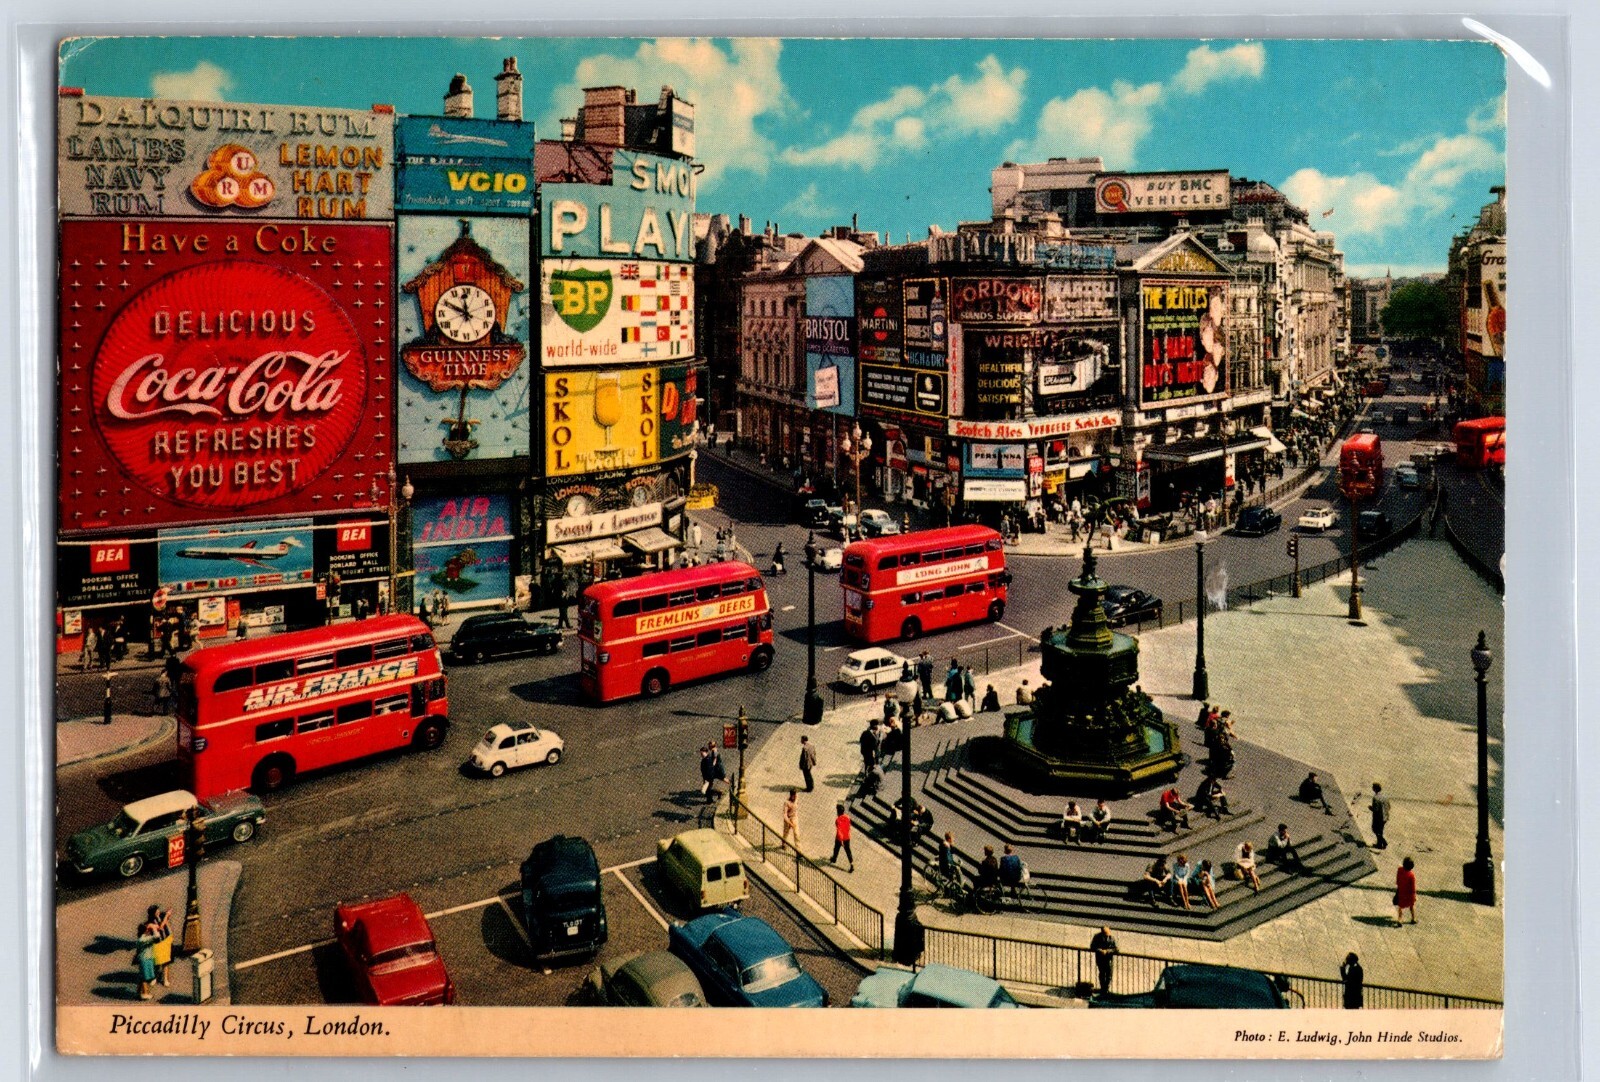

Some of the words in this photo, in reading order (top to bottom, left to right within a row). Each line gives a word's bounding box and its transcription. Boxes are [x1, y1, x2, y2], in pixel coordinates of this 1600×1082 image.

[77, 102, 274, 134] DAIQUIRI
[290, 112, 378, 139] RUM
[279, 143, 384, 169] LEMON
[85, 165, 171, 190] NAVY
[293, 171, 374, 195] HART
[1147, 181, 1176, 192] BUY
[1180, 178, 1212, 191] BMC
[90, 192, 165, 216] RUM
[298, 197, 367, 218] RUM
[1135, 193, 1224, 206] VEHICLES
[120, 224, 209, 252] Have
[226, 232, 239, 252] a
[255, 225, 338, 254] Coke
[552, 200, 697, 259] PLAY
[561, 280, 609, 315] BP
[1143, 287, 1163, 310] THE
[1165, 287, 1208, 310] BEATLES
[154, 309, 317, 335] DELICIOUS
[805, 319, 850, 341] BRISTOL
[862, 319, 899, 331] MARTINI
[420, 349, 511, 363] GUINNESS
[546, 338, 618, 358] world-wide
[444, 363, 489, 377] TIME
[979, 363, 1025, 374] HEALTHFUL
[106, 350, 351, 419] Coca-Cola
[977, 377, 1021, 389] DELICIOUS
[977, 393, 1022, 404] SATISFYING
[553, 377, 572, 470] SKOL
[640, 373, 654, 460] SKOL
[154, 424, 317, 455] REFRESHES
[955, 421, 992, 438] Scotch
[996, 423, 1023, 438] Ales
[974, 452, 1022, 461] PERSNNA
[171, 463, 224, 488] YOU
[235, 458, 300, 485] BEST
[438, 497, 491, 519] AIR
[341, 528, 367, 542] BEA
[421, 516, 506, 543] INDIA
[95, 547, 124, 563] BEA
[914, 567, 943, 579] LONG
[944, 562, 972, 575] JOHN
[639, 608, 700, 631] FREMLINS
[718, 598, 753, 616] BEERS
[242, 681, 299, 710] AIR
[302, 656, 419, 694] FRANCE
[170, 839, 184, 851] NO
